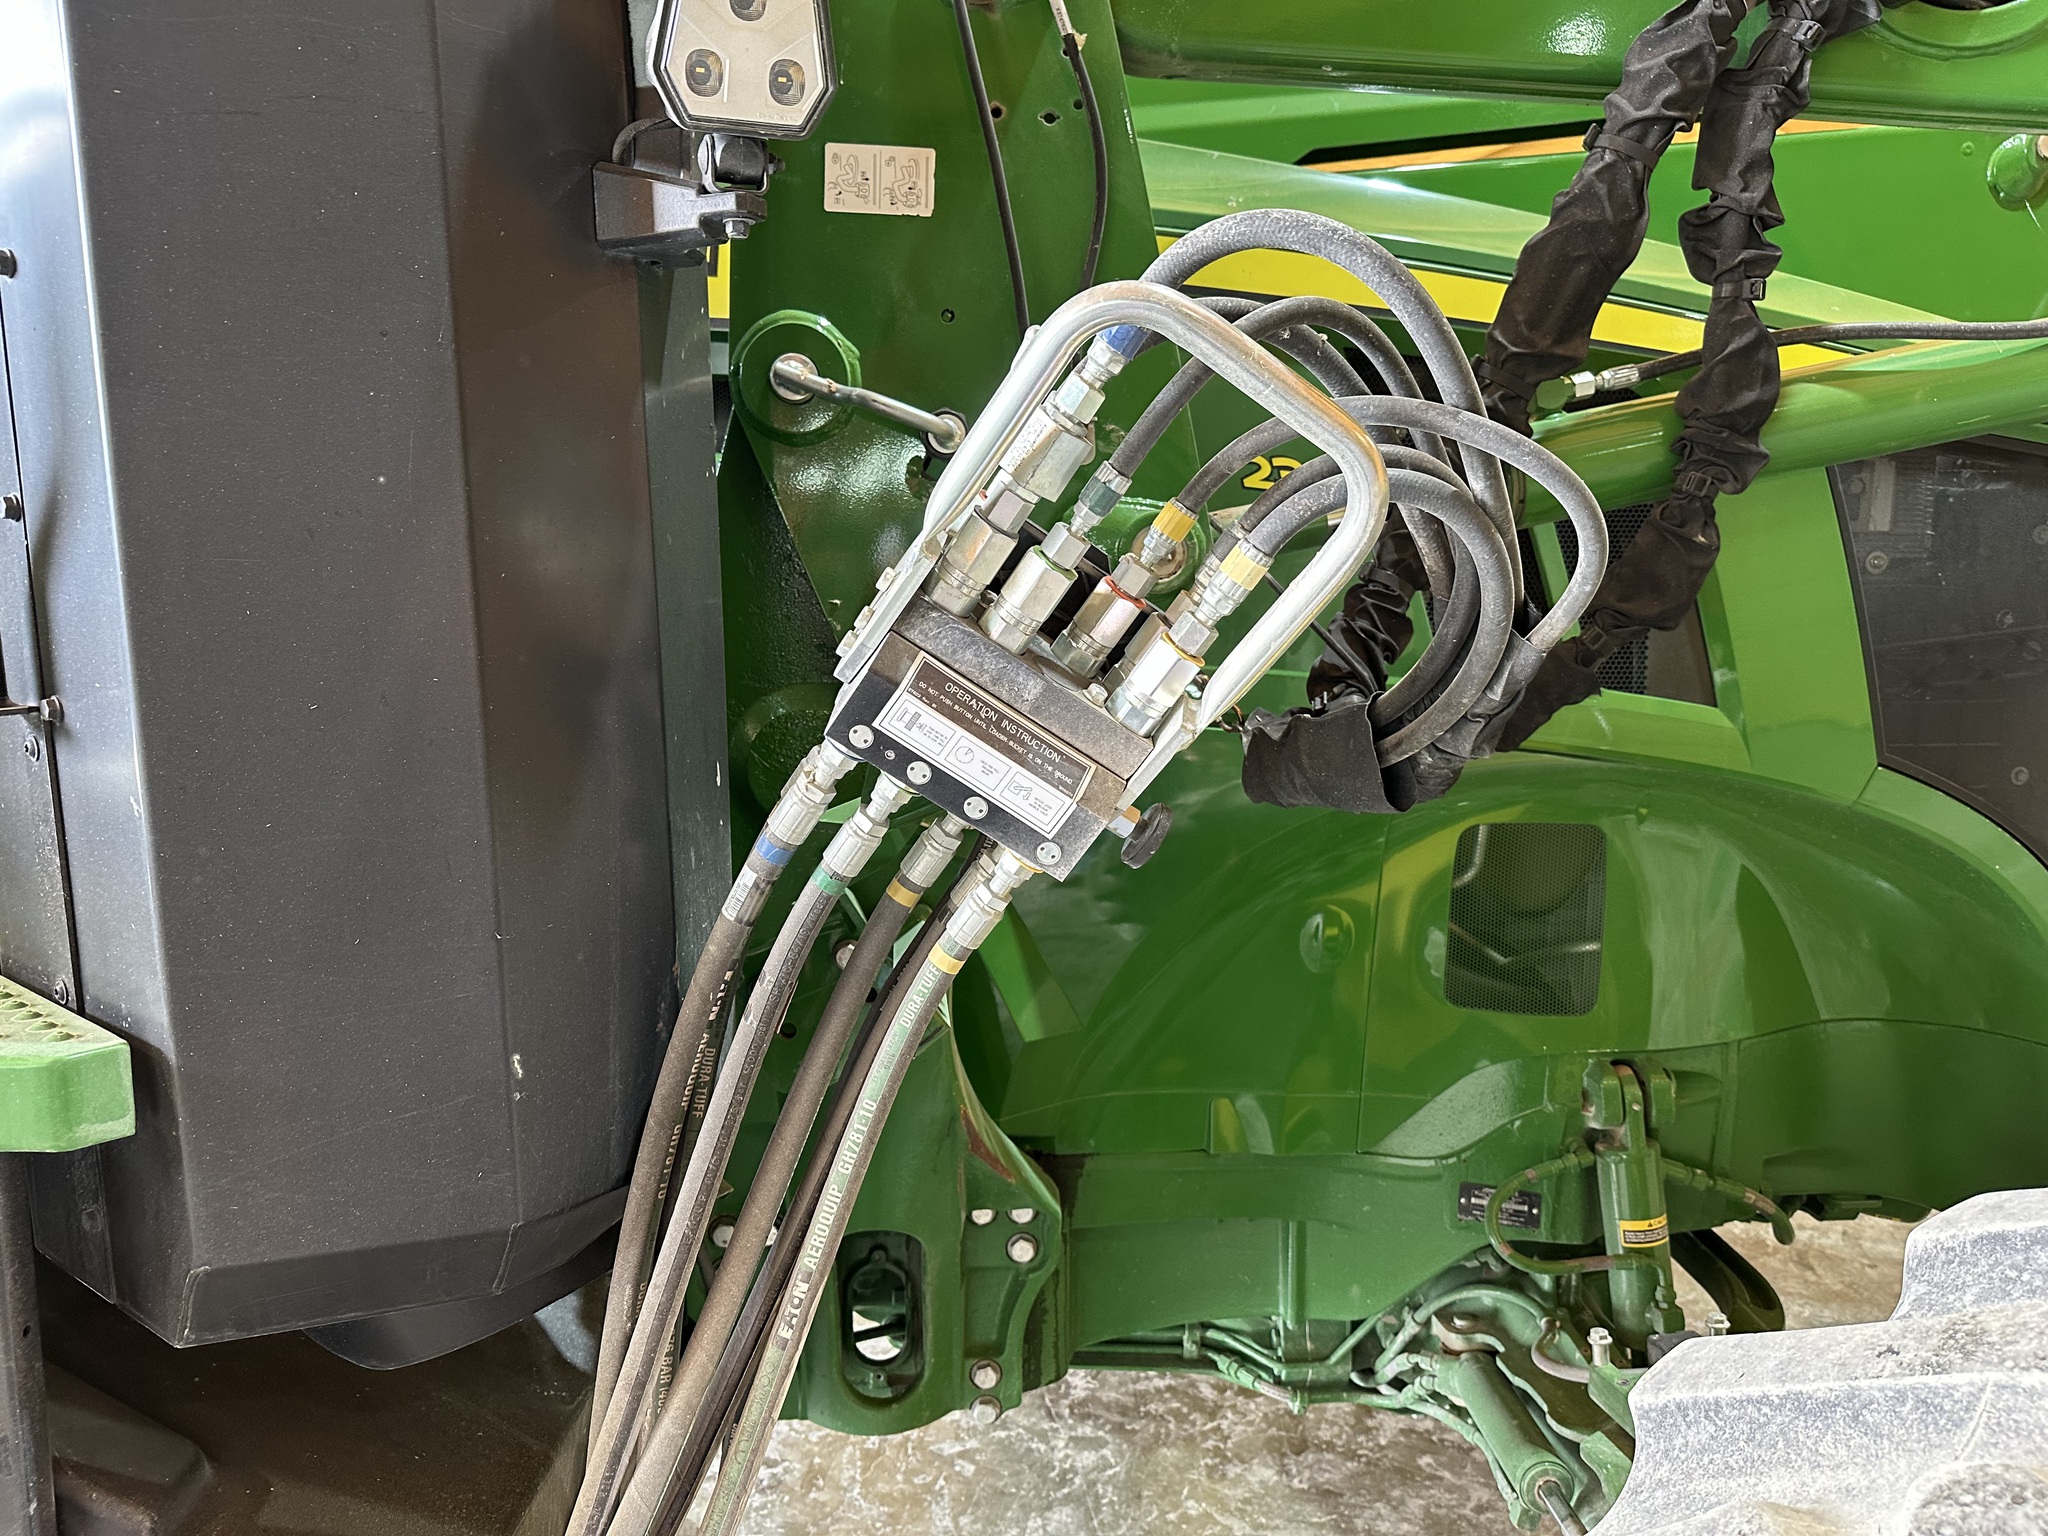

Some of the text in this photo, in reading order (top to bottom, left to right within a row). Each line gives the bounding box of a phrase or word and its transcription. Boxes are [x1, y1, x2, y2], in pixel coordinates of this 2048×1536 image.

[918, 680, 927, 689] DO
[927, 686, 939, 697] NOT
[938, 694, 953, 706] PUSH
[953, 703, 973, 719] BUTTON
[973, 716, 988, 729] UNTIL
[988, 726, 1008, 742] LOADER
[1007, 739, 1027, 755] BUCKET
[1033, 756, 1042, 765] ON
[1042, 762, 1053, 772] THE
[943, 681, 998, 722] OPERATION
[999, 718, 1062, 764] INSTRUCTION
[899, 965, 941, 1028] DURA-TUFF
[804, 1183, 842, 1270] AEROQUIP
[837, 1098, 879, 1177] GH781-10
[659, 1355, 674, 1384] BAR
